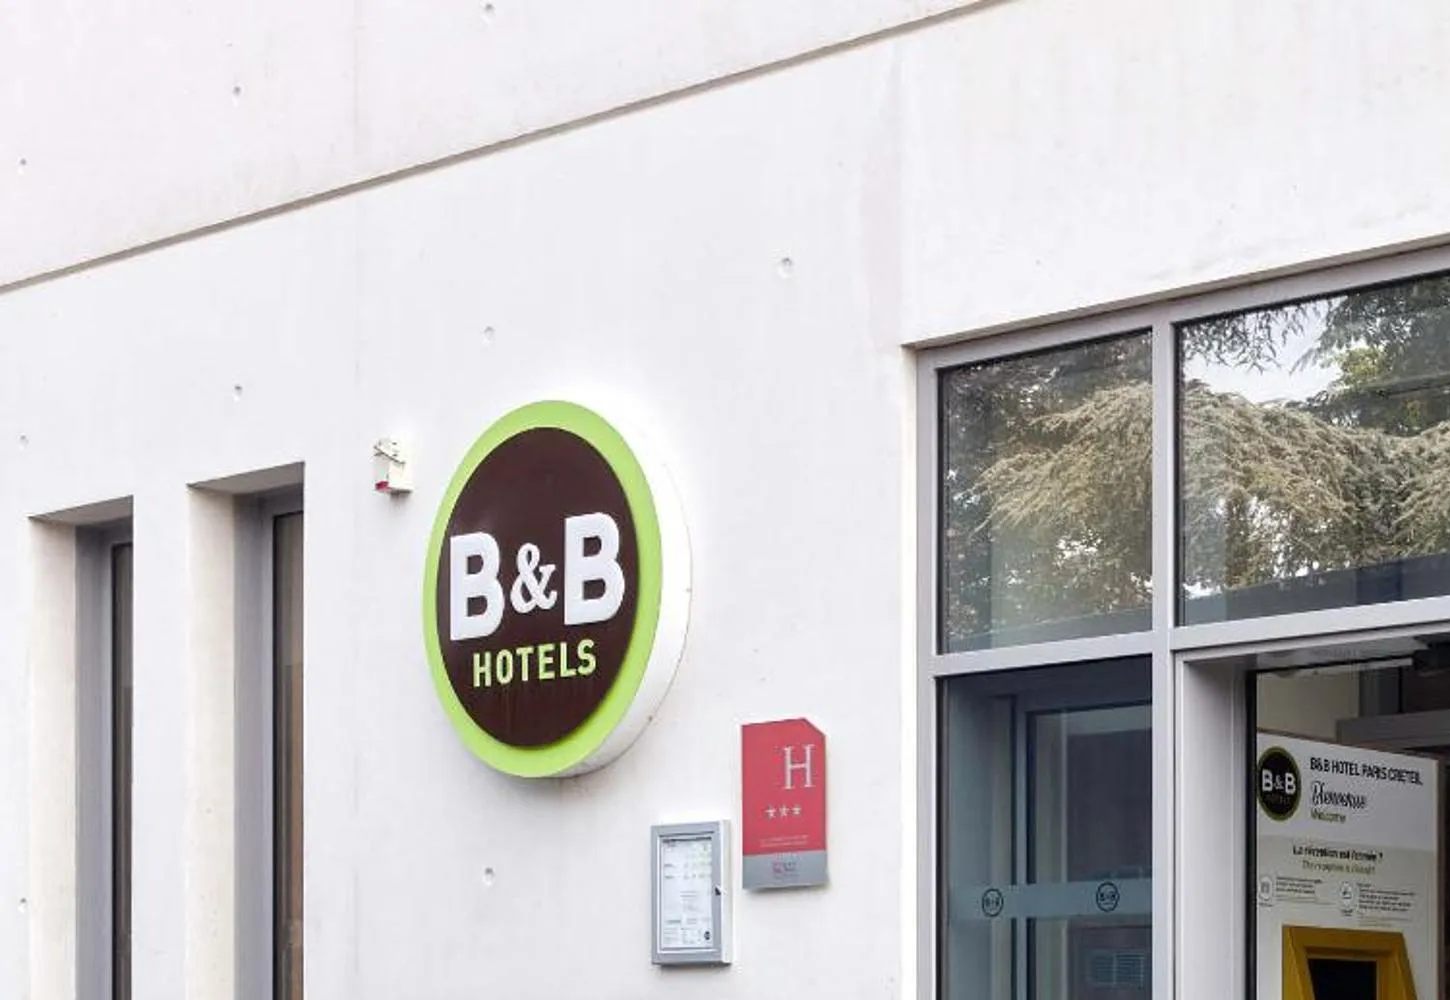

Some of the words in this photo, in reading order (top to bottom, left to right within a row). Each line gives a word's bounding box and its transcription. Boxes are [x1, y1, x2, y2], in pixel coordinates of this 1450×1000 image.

[448, 511, 626, 641] B&B
[472, 638, 598, 689] HOTELS
[781, 743, 817, 790] H
[1261, 769, 1297, 794] B&B
[1310, 757, 1331, 772] B&B
[1331, 760, 1360, 777] HOTEL
